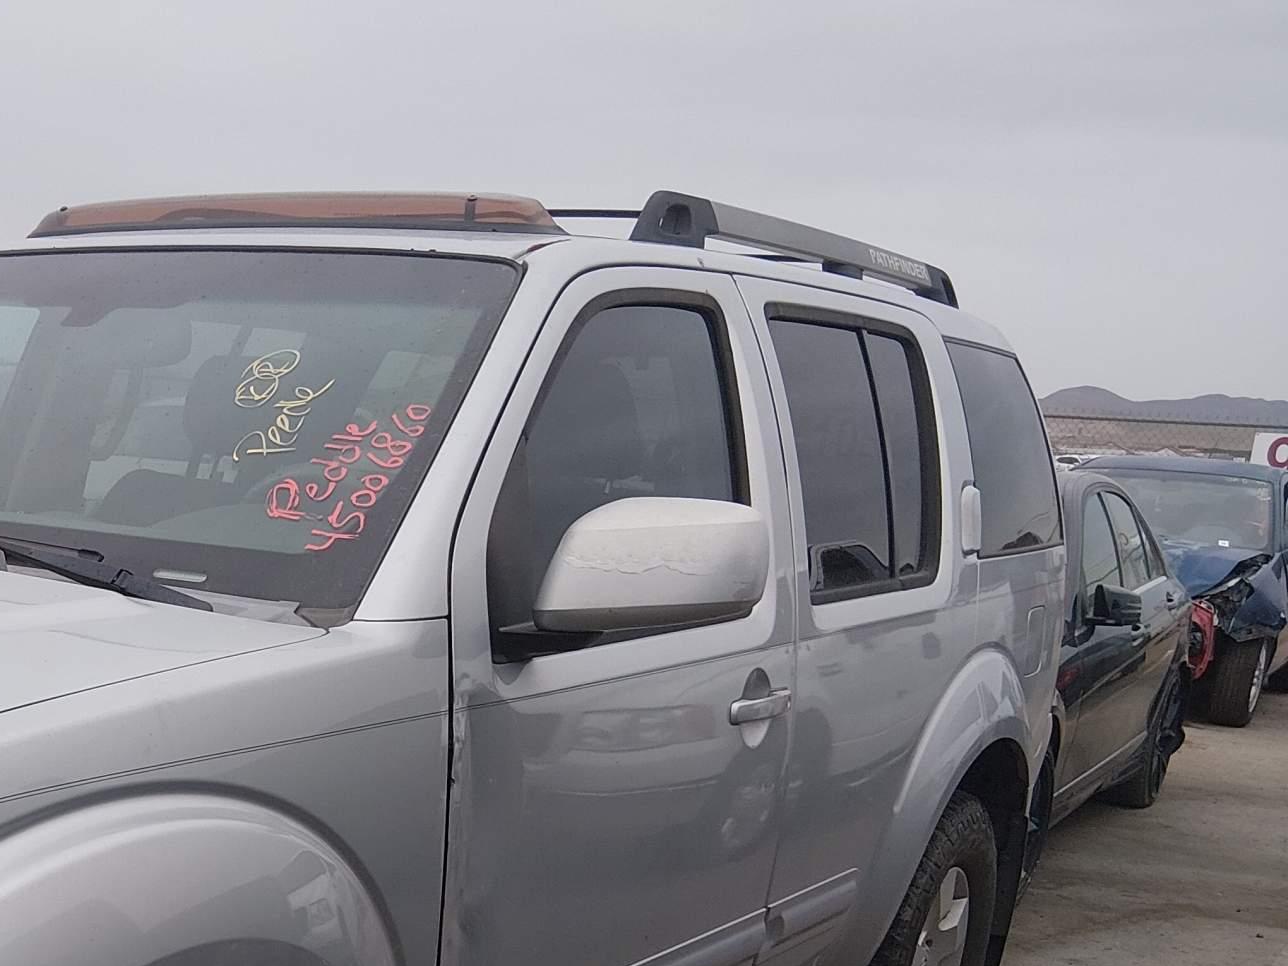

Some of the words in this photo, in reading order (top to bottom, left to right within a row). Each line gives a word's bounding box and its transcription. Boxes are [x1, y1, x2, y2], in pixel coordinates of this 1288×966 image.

[868, 248, 929, 281] PATHFINDER
[266, 420, 378, 520] Peddle
[304, 403, 432, 551] 45006860
